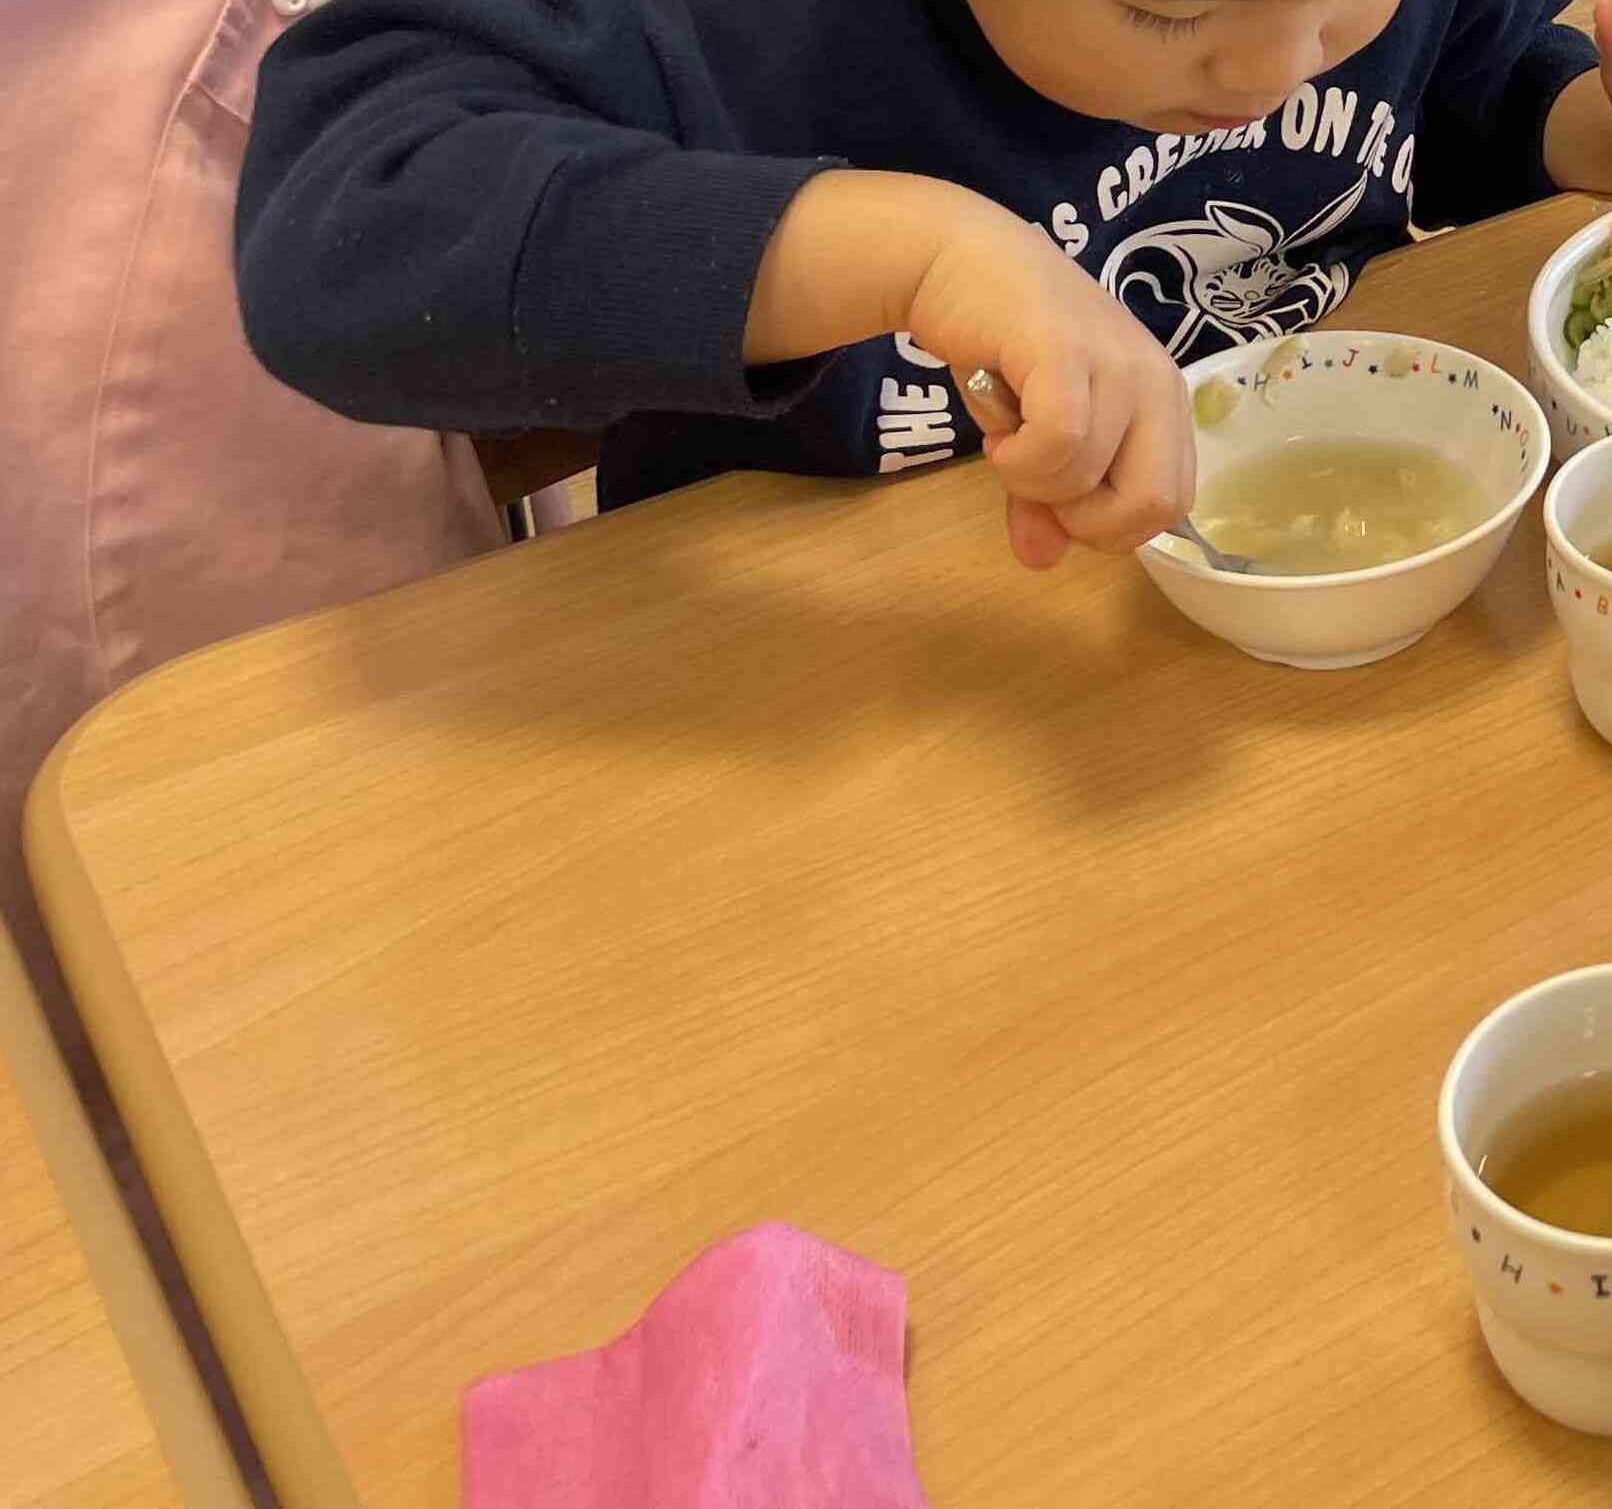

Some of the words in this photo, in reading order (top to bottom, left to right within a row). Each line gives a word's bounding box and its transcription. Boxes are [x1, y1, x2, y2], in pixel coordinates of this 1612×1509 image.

[1281, 81, 1359, 158] ON
[876, 376, 957, 474] THE
[1342, 348, 1360, 368] J
[1463, 369, 1480, 389] M
[1500, 409, 1512, 431] N
[1501, 1253, 1524, 1284] H
[1591, 1273, 1612, 1299] I
